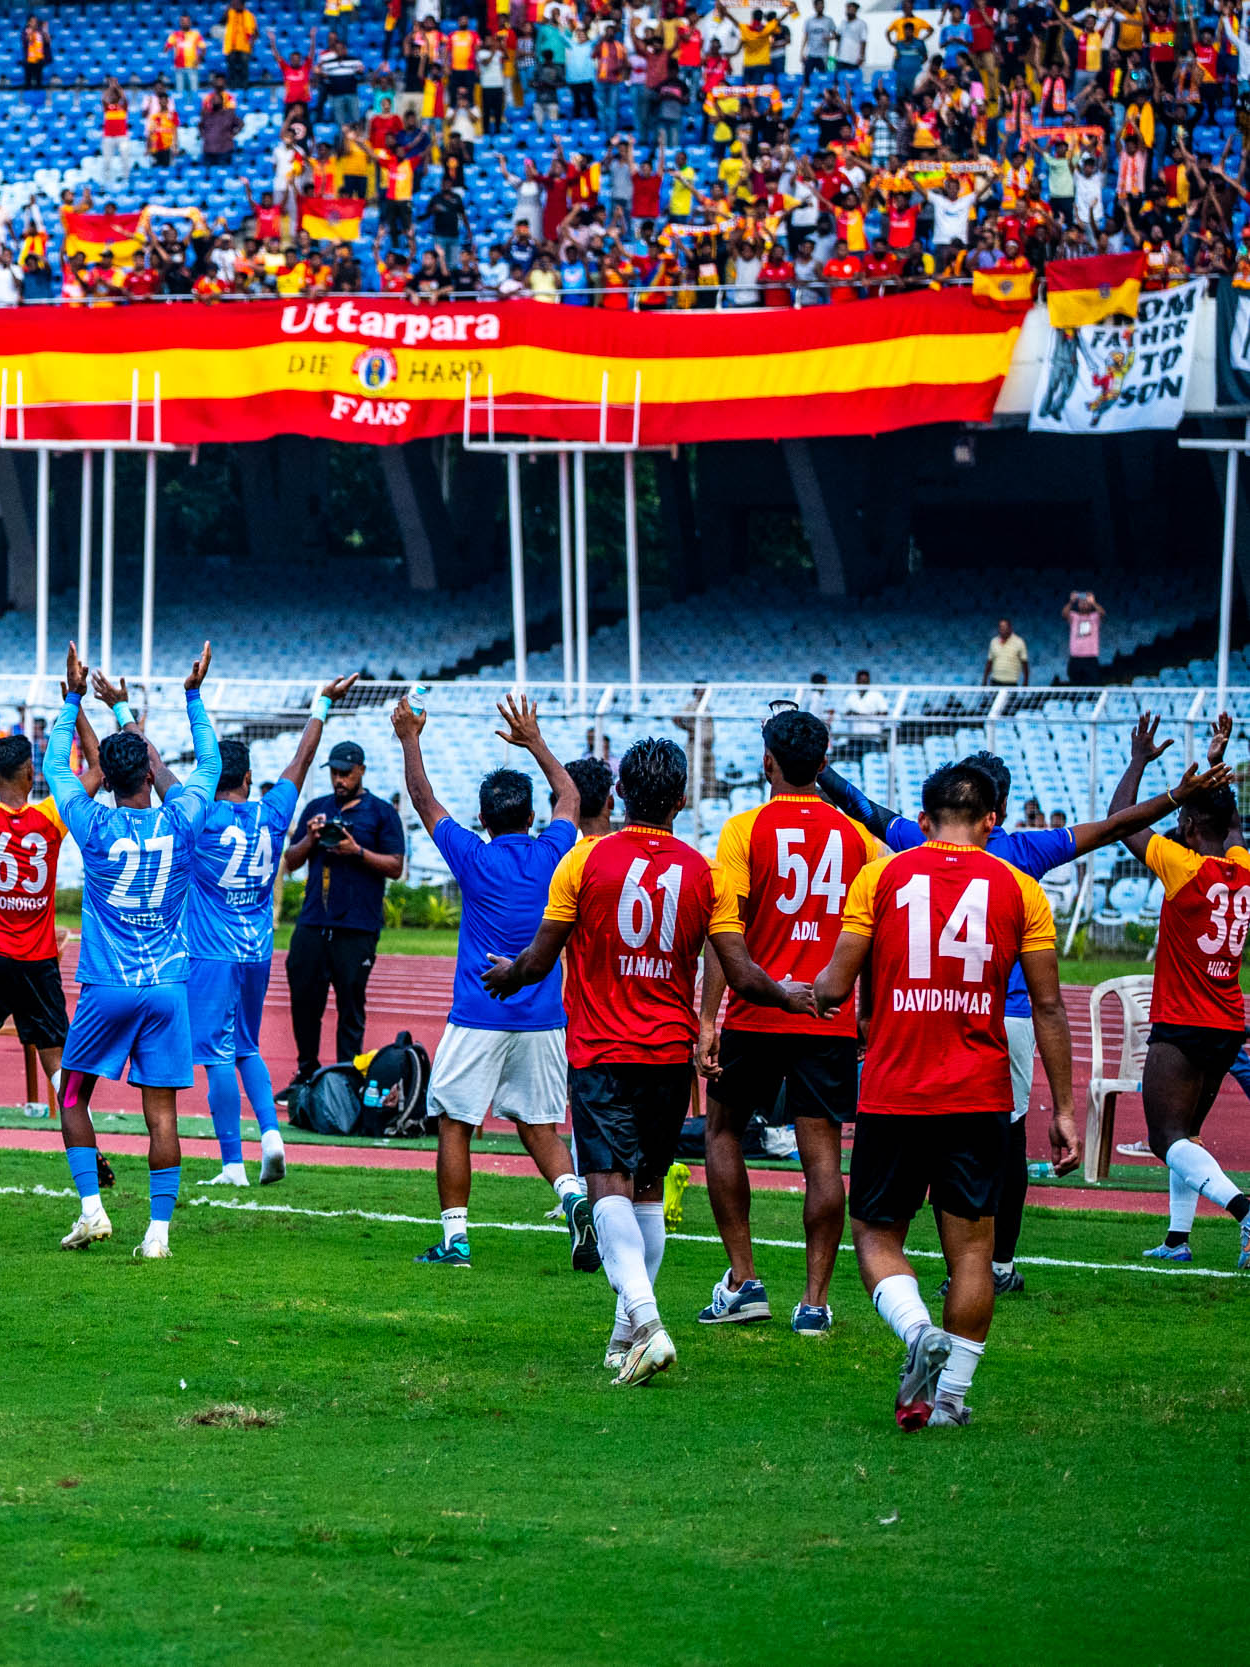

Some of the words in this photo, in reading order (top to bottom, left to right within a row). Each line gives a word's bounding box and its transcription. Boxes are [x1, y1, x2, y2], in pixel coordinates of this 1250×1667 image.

[281, 301, 499, 344] Uttarpara
[1137, 288, 1196, 323] OM
[287, 354, 333, 375] DIE
[1140, 345, 1182, 376] TO
[330, 394, 411, 426] FANS
[1120, 377, 1183, 408] SON
[106, 835, 174, 908] 27
[218, 825, 274, 889] 24
[776, 828, 846, 915] 54
[617, 857, 683, 952] 61
[1197, 883, 1250, 957] 38
[790, 921, 821, 941] ADIL
[896, 874, 993, 982] 14
[618, 955, 673, 979] TANMAY
[893, 988, 992, 1015] DAVIDHMAR
